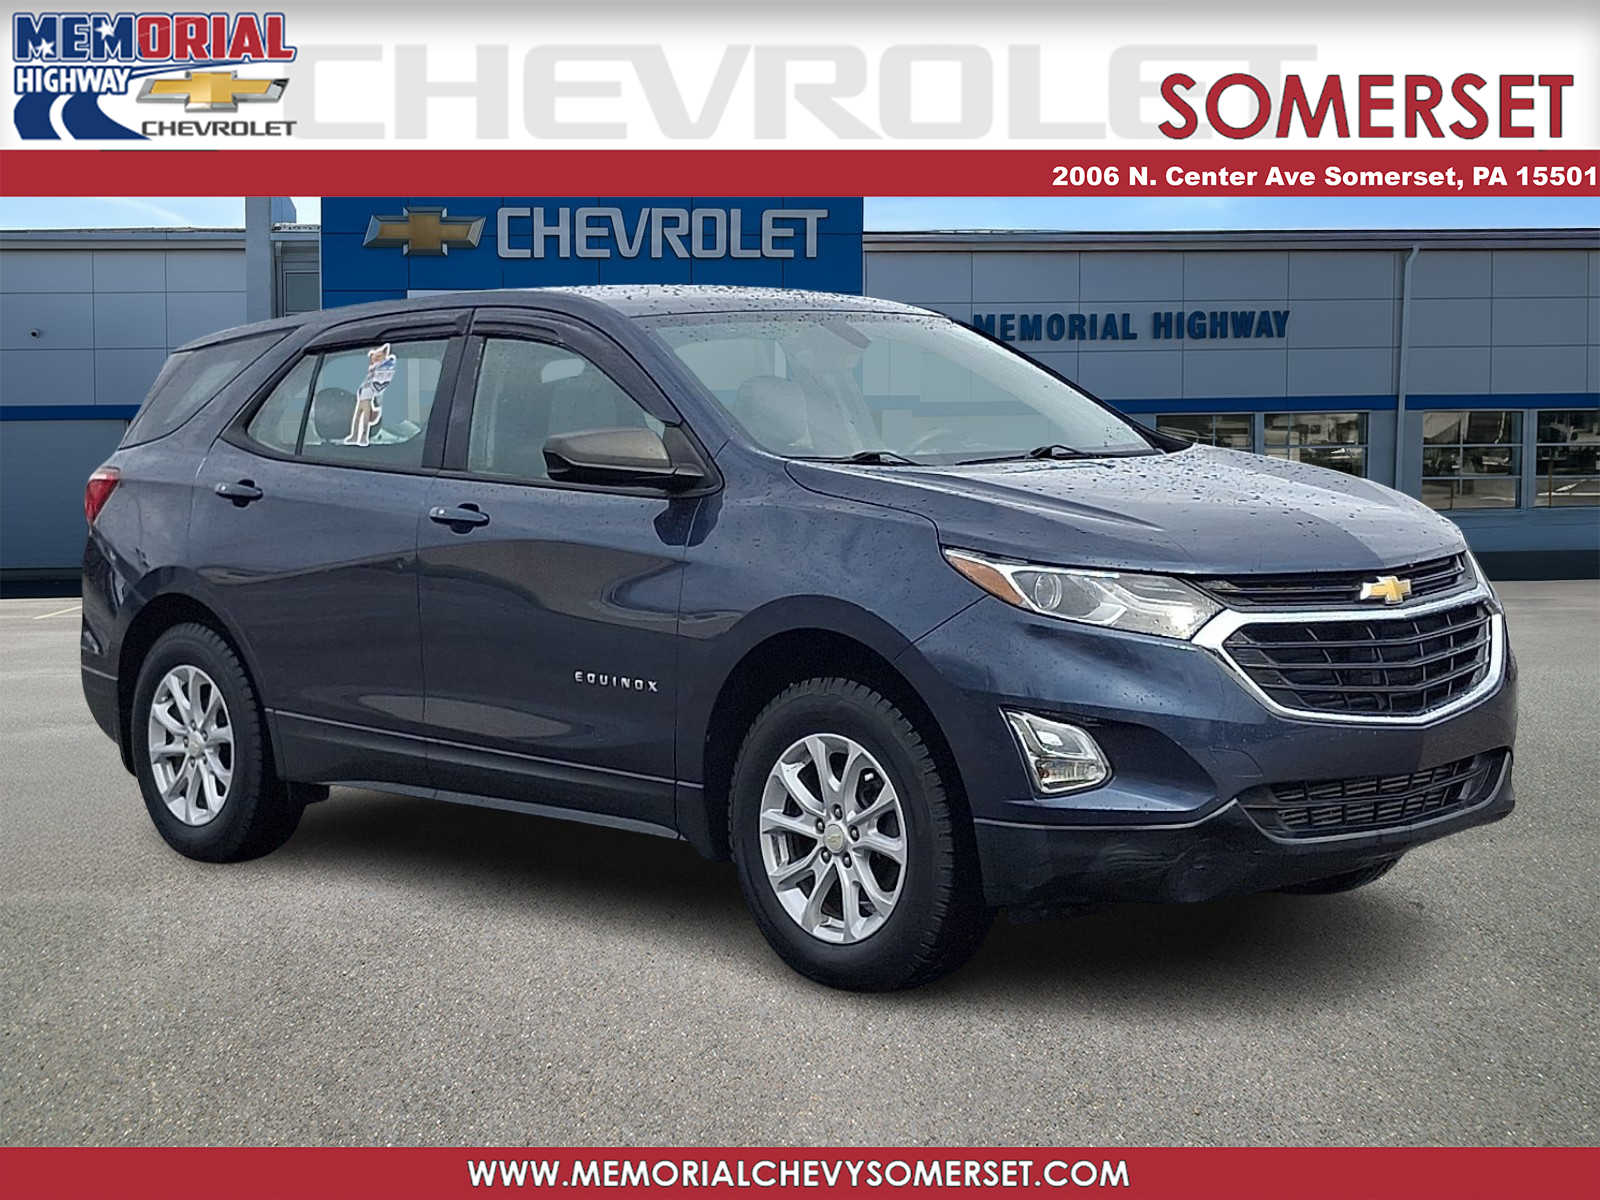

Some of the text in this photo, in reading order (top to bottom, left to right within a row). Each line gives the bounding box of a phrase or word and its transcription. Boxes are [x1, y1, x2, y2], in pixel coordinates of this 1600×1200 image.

[496, 206, 828, 259] CHEVROLET
[973, 310, 1291, 341] MEMORIAL HIGHWAY
[574, 670, 658, 692] EQUINOX
